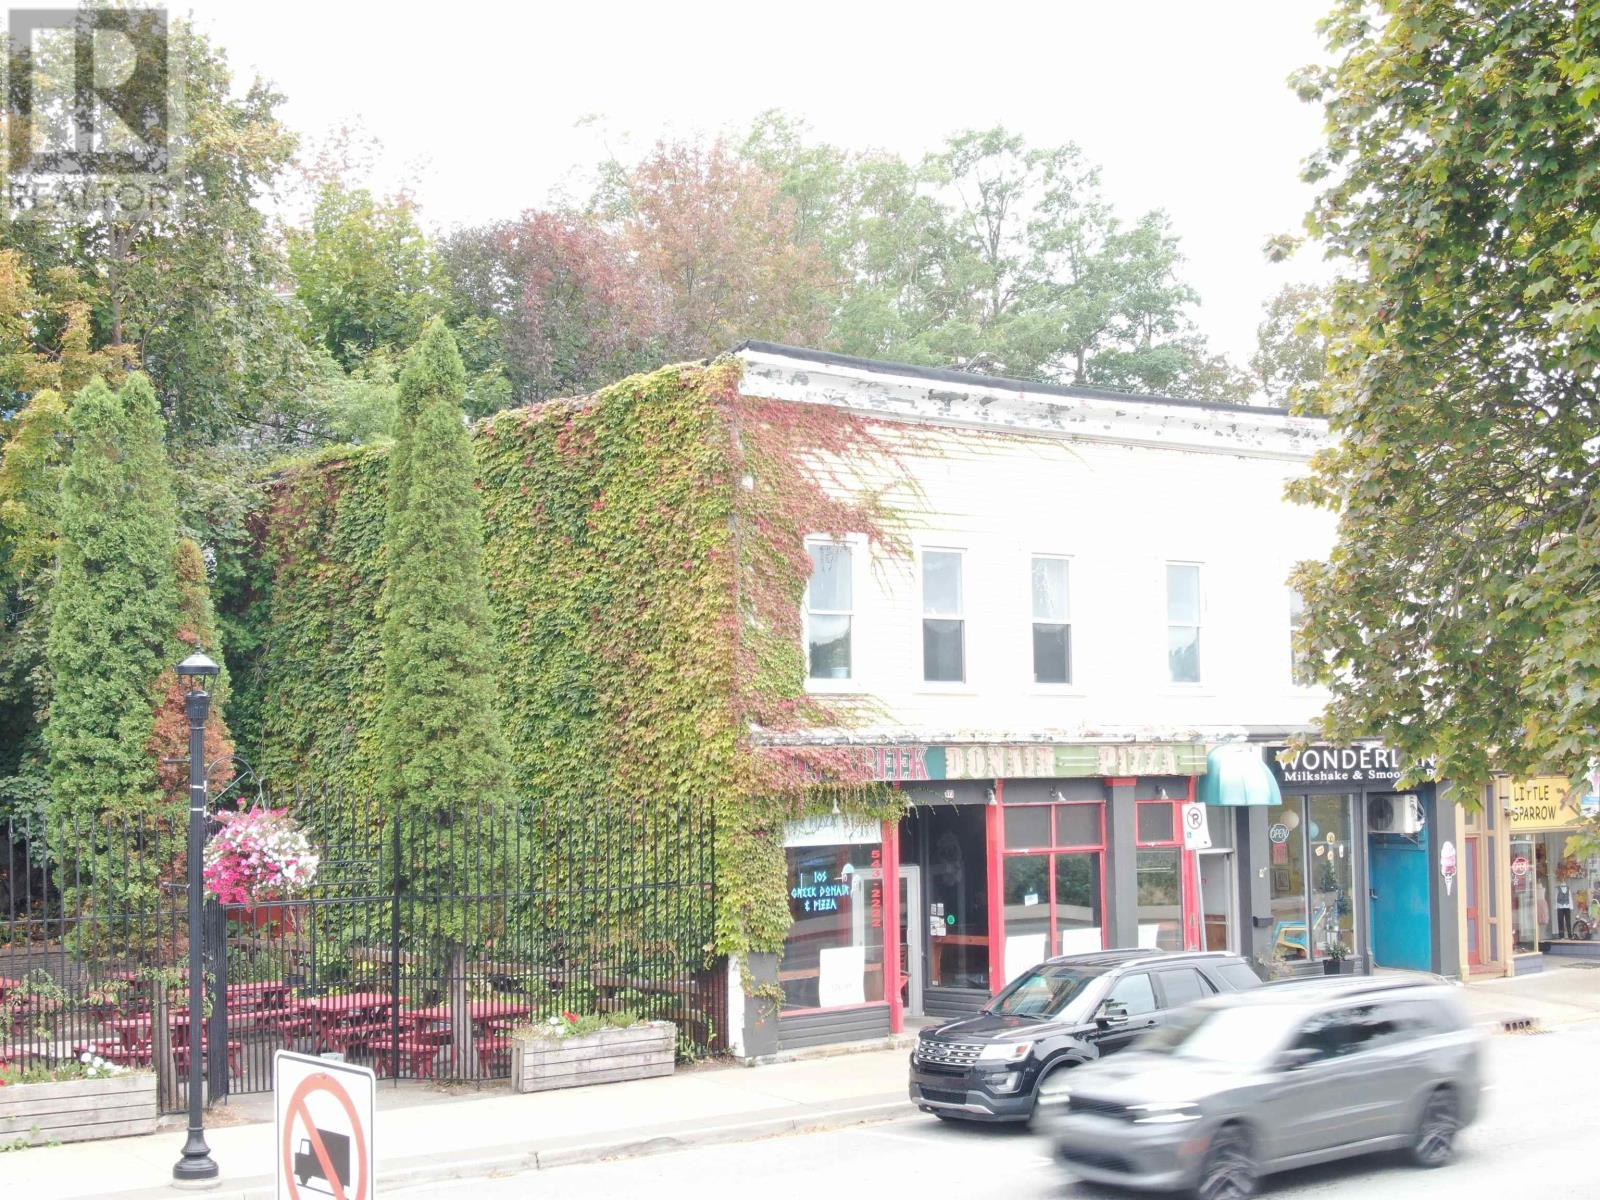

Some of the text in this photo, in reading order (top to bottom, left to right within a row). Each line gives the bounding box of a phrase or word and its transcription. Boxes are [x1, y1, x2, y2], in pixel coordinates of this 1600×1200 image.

[862, 746, 929, 780] REEK
[1098, 746, 1177, 776] PIZZA
[1284, 769, 1400, 781] Milkshake & Smoo
[1513, 785, 1549, 801] LITTLE
[1513, 805, 1556, 822] SPARROW
[791, 884, 850, 899] GREEK DONAIR
[813, 898, 837, 911] PIZZA
